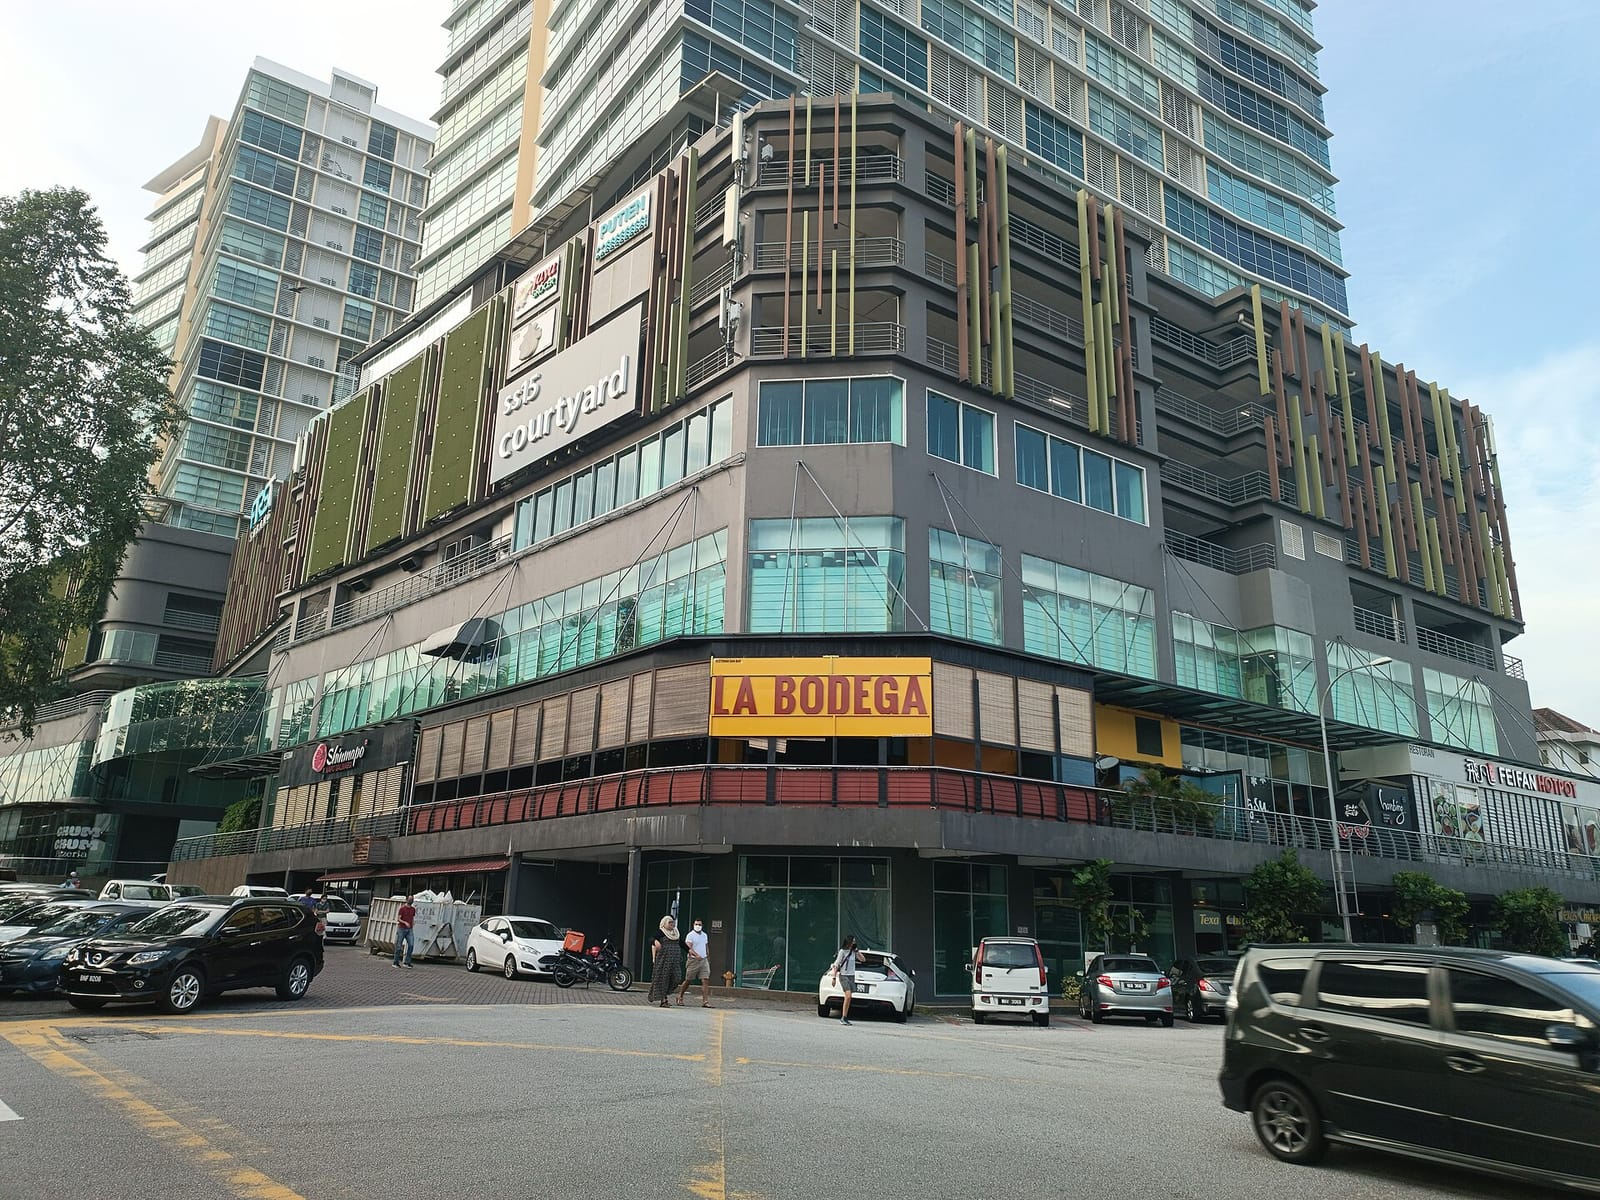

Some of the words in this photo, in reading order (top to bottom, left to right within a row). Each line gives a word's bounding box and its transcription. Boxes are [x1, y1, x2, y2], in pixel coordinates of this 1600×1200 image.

[600, 195, 646, 239] PUTIEN
[499, 353, 630, 459] courtyard
[714, 675, 758, 715] LA
[774, 674, 928, 715] BODEGA
[1409, 744, 1435, 758] RESTORAN
[1499, 766, 1537, 791] FEIFAN
[1536, 774, 1577, 799] HOTPOT
[1378, 788, 1407, 825] hanbing
